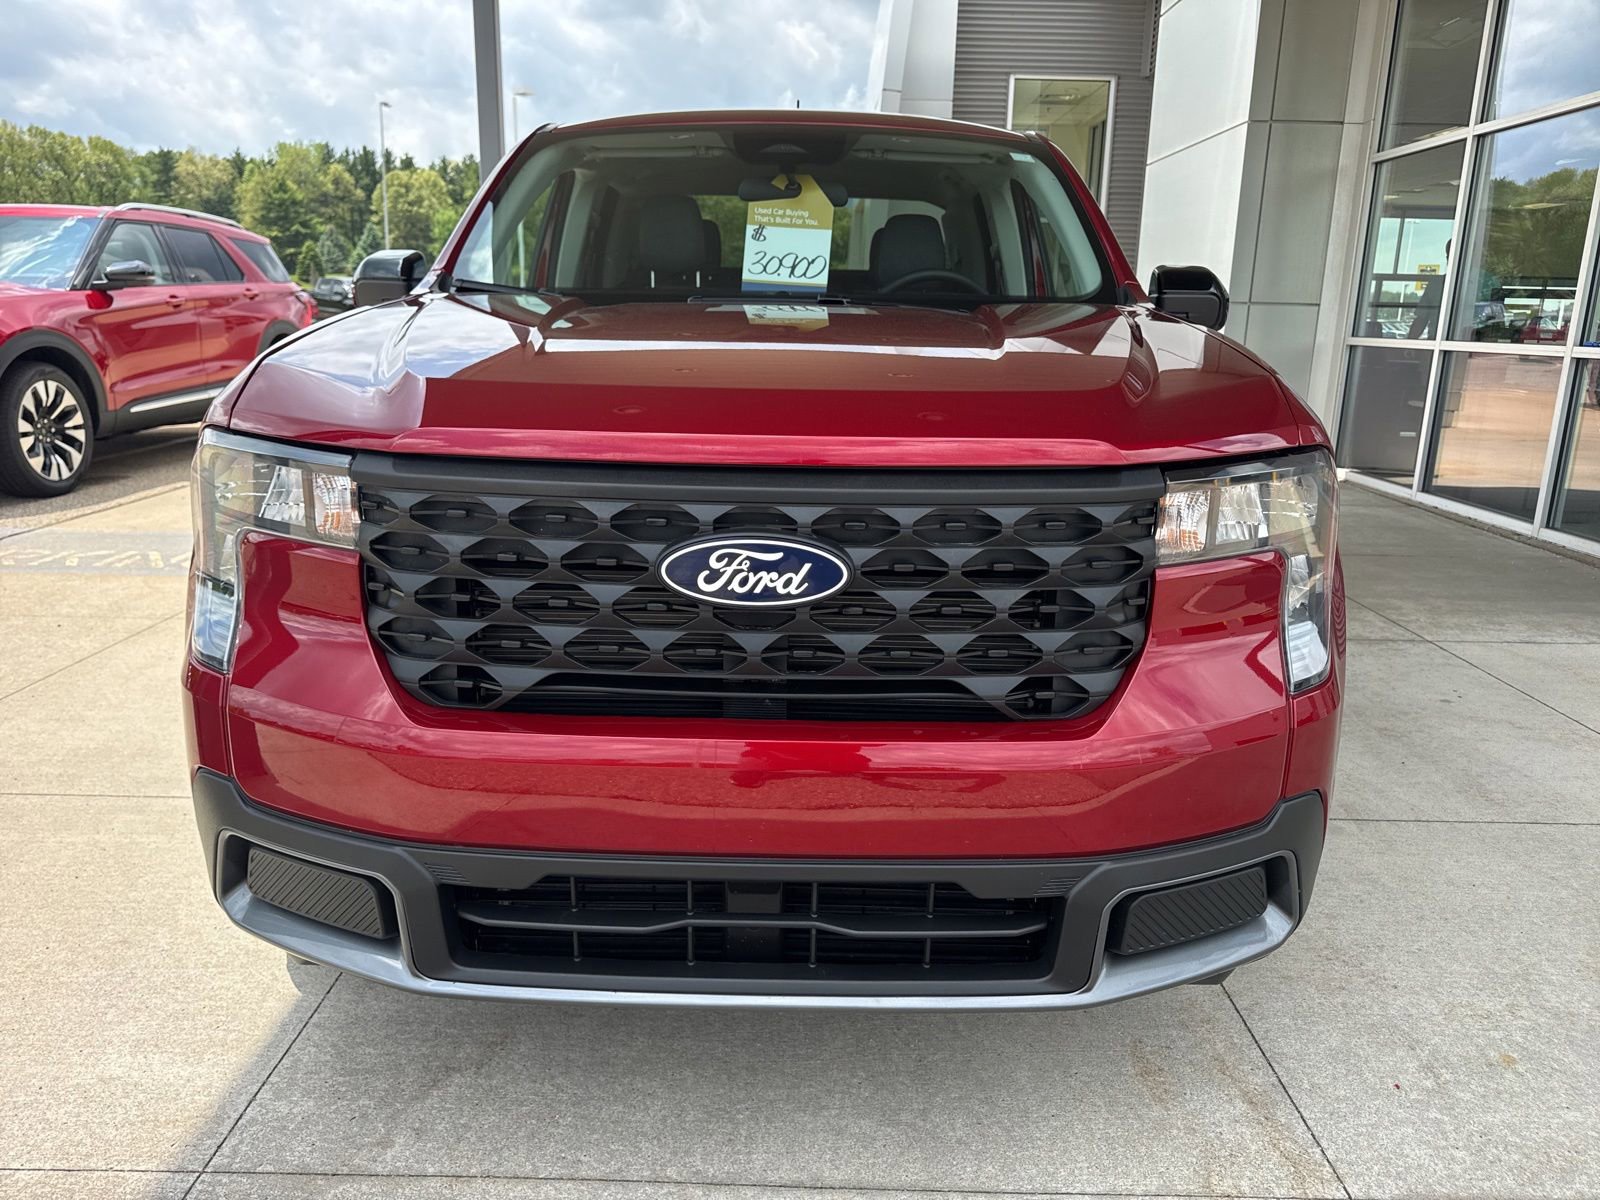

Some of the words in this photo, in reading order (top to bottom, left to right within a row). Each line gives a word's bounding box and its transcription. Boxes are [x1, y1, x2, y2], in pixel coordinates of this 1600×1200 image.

[754, 207, 772, 215] Used
[785, 209, 809, 218] Buying
[775, 216, 791, 224] Built
[792, 217, 804, 225] For
[751, 224, 767, 242] $
[697, 548, 813, 595] Ford
